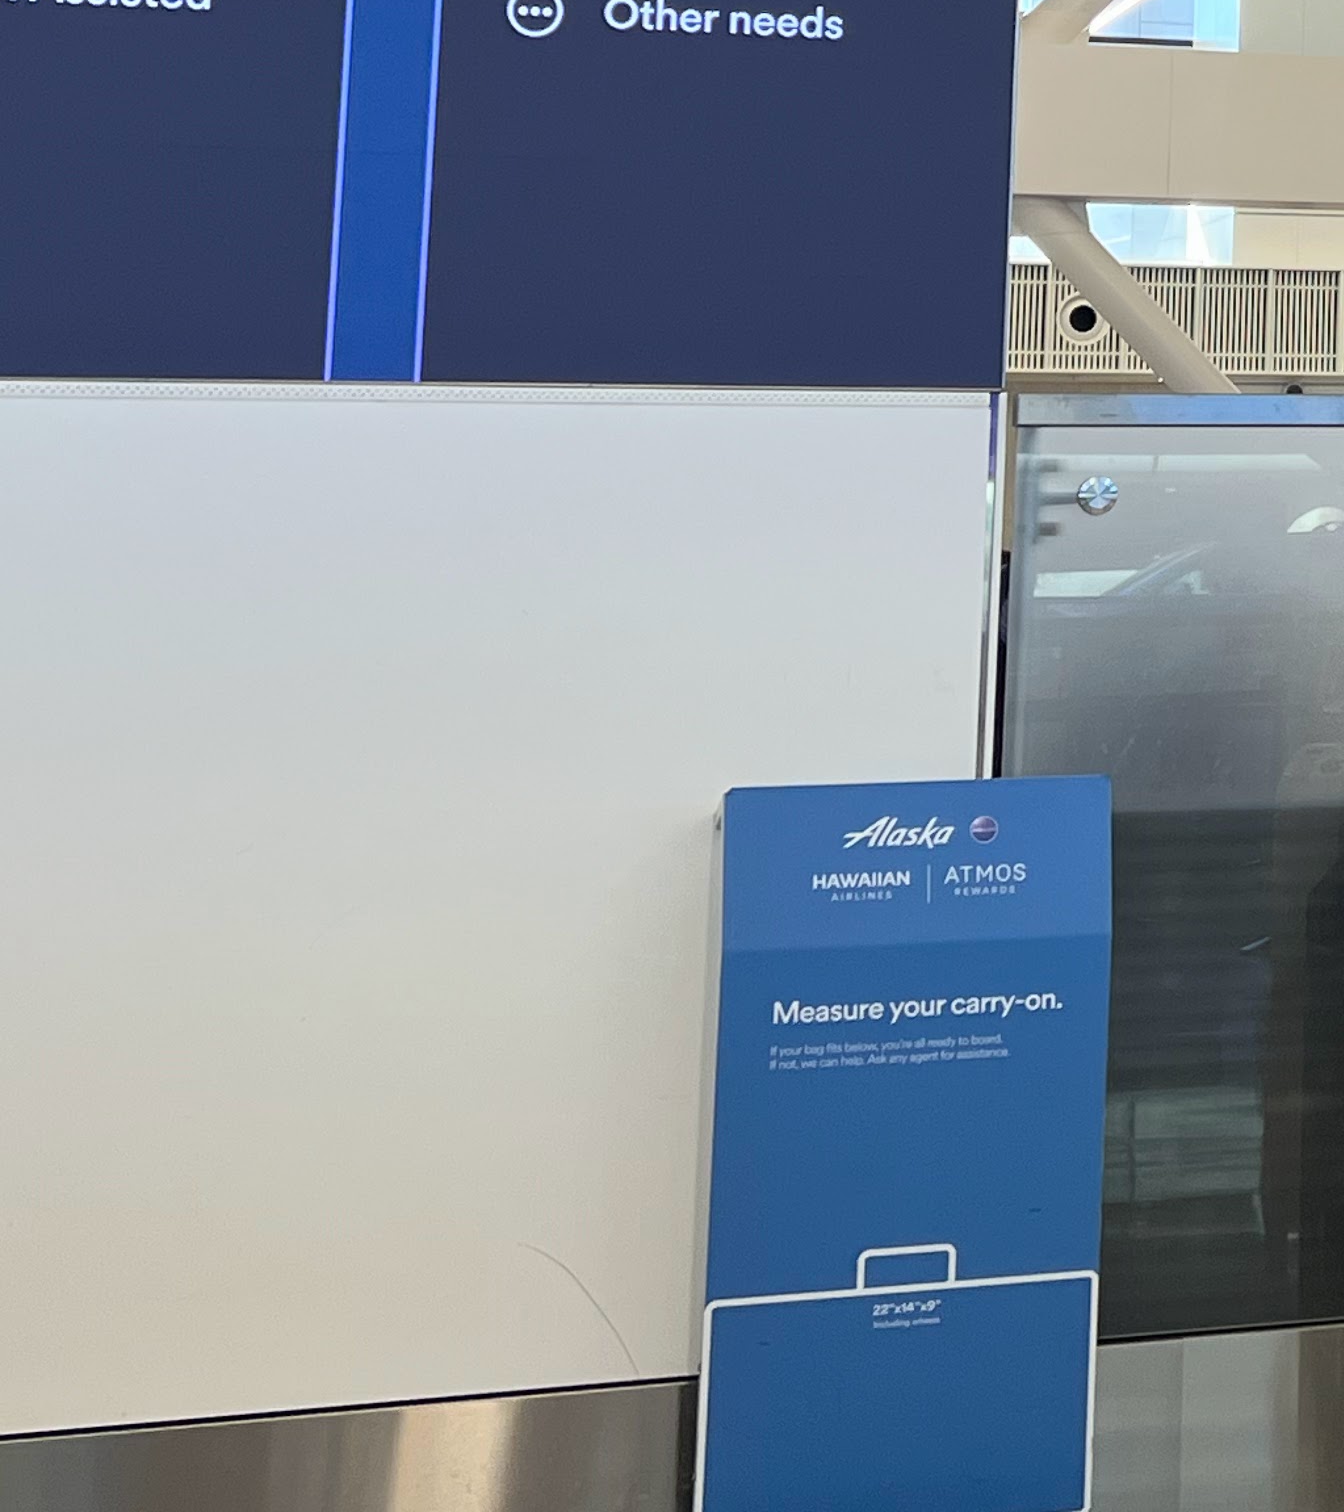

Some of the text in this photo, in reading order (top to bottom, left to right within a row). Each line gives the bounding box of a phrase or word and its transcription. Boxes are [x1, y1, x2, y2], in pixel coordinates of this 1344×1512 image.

[729, 5, 844, 40] needs
[843, 816, 956, 849] Alaska
[812, 863, 1027, 890] HAWAIIAN ATMOS
[831, 885, 1016, 902] AIRLINES REWARDS
[772, 992, 1063, 1025] Measure your carry-on.
[779, 1047, 803, 1058] your
[804, 1044, 825, 1056] bag
[958, 1037, 969, 1046] to
[819, 1059, 839, 1068] can
[867, 1053, 886, 1065] Ask
